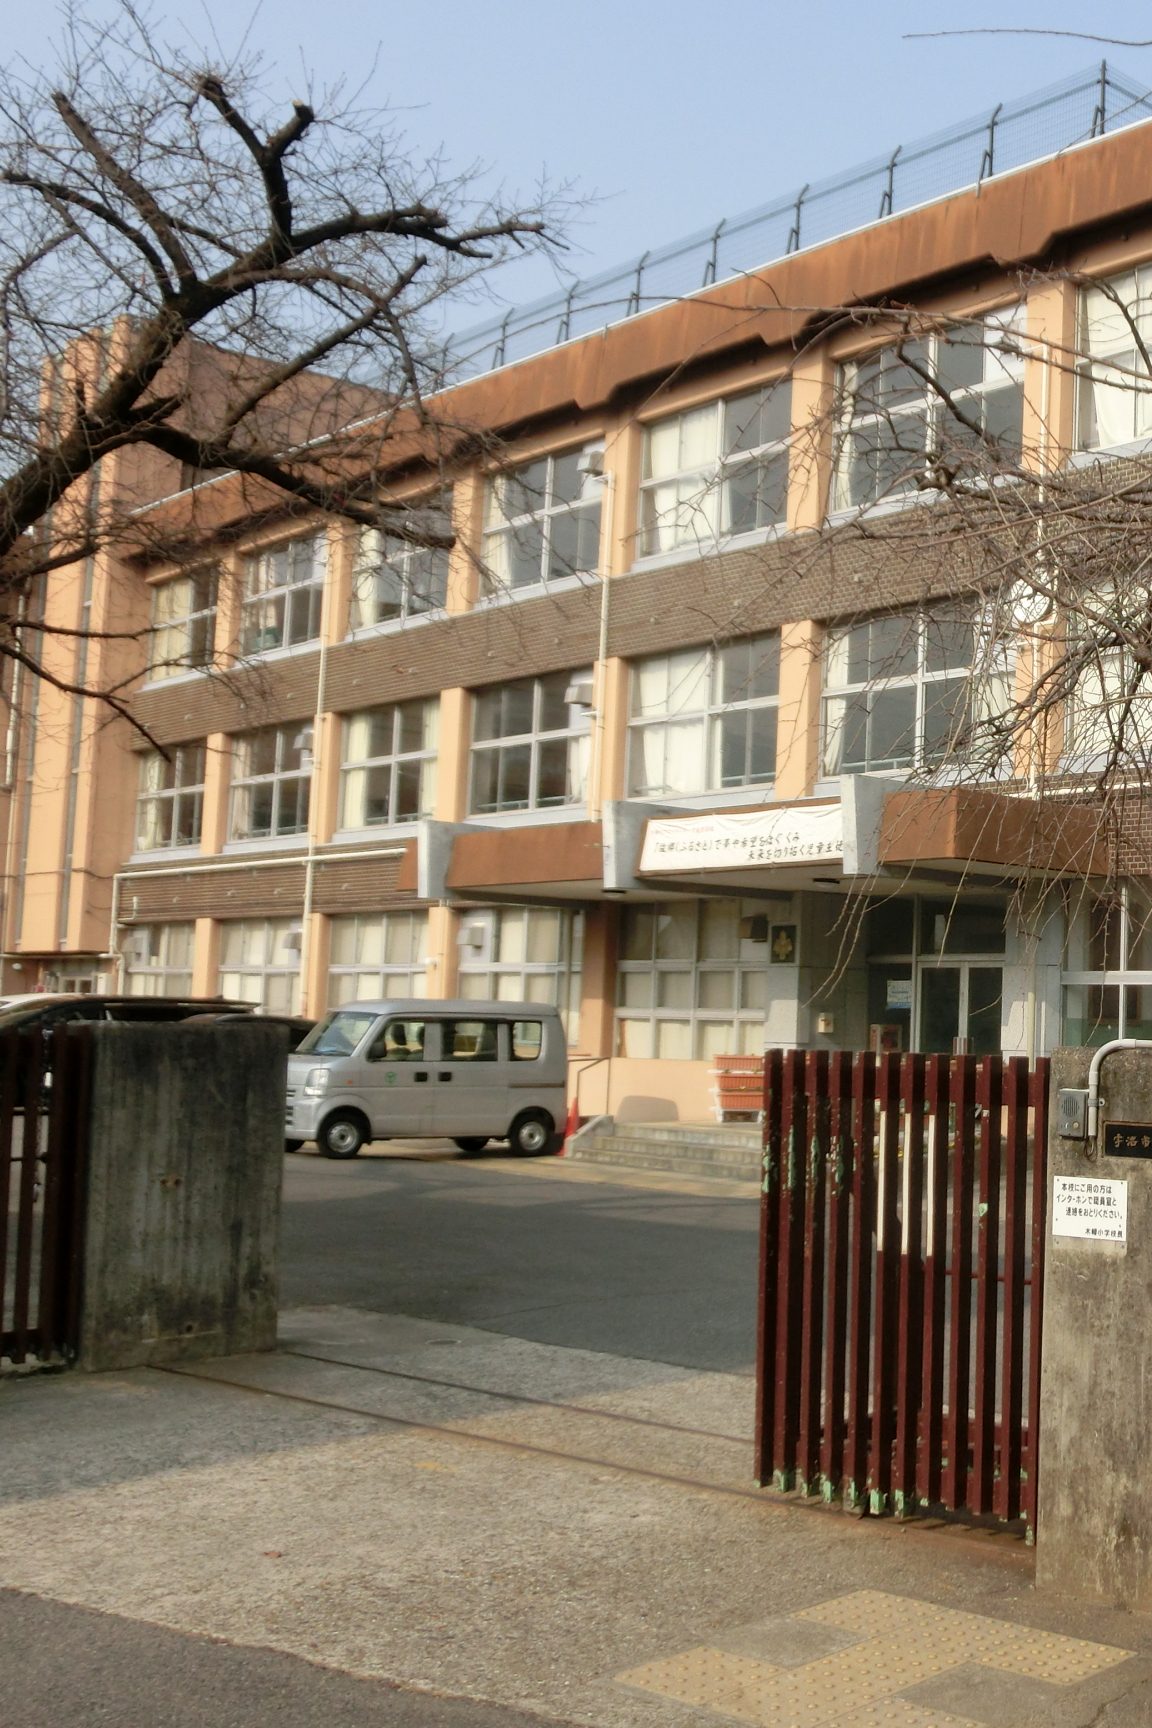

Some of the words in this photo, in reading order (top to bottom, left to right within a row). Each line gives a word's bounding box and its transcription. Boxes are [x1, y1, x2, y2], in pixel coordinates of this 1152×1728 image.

[1061, 1183, 1112, 1195] 本校にご用の方は
